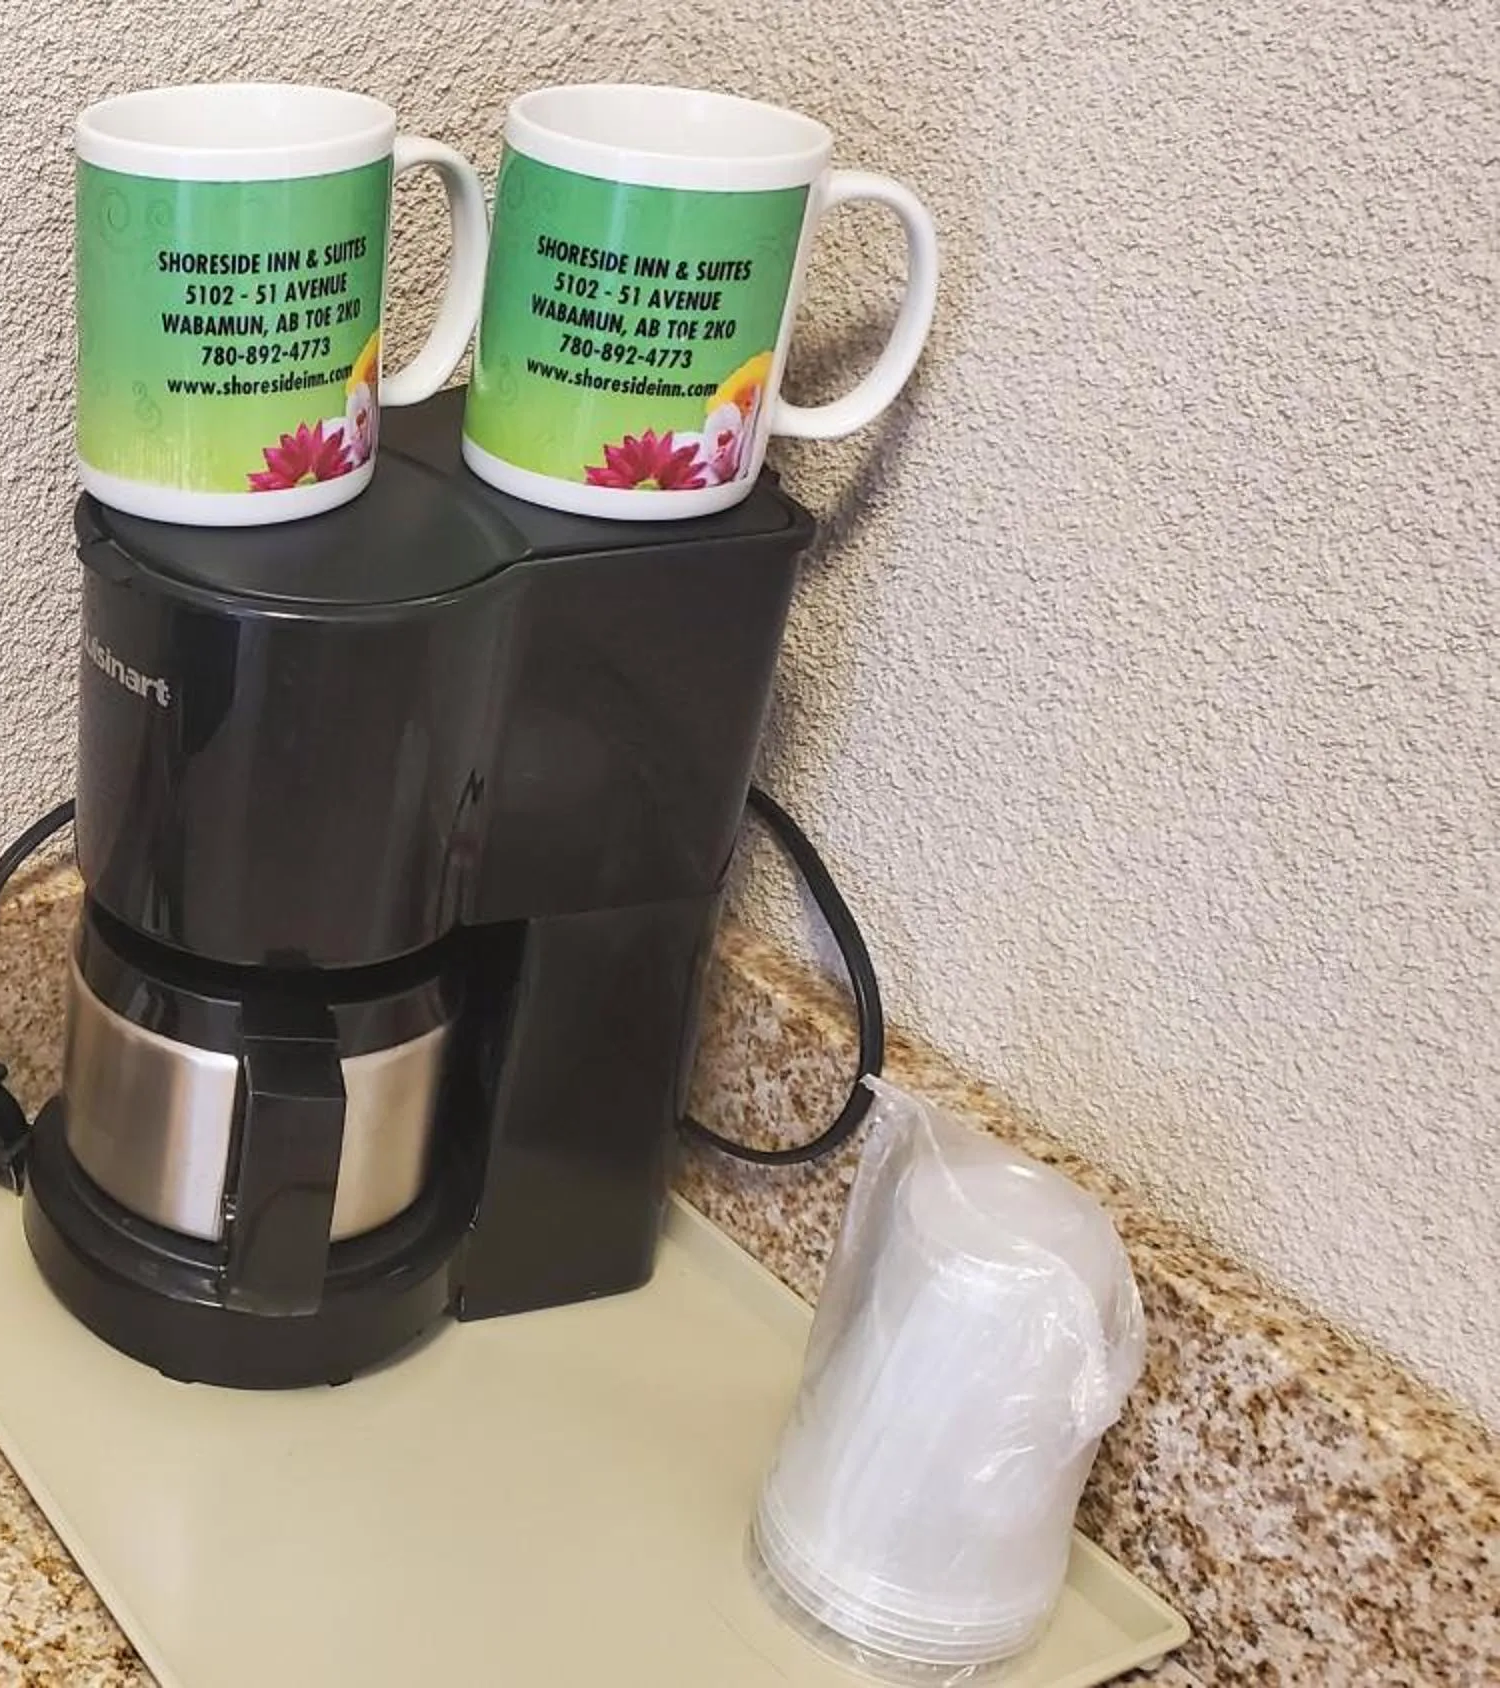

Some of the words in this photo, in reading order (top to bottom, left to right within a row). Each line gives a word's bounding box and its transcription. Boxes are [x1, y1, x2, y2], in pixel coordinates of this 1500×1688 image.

[158, 251, 260, 275] SHORESIDE
[267, 250, 300, 273] INN
[306, 249, 318, 268] &
[323, 236, 367, 267] SUITES
[536, 235, 629, 275] SHORESIDE
[633, 255, 671, 279] INN
[675, 261, 689, 281] &
[696, 259, 753, 281] SUITES
[185, 284, 234, 305] 5102
[255, 283, 277, 304] 51
[285, 272, 347, 302] AVENUE
[553, 271, 600, 299] 5102
[617, 284, 641, 306] 51
[647, 289, 722, 311] AVENUE
[161, 312, 269, 338] WABAMUN,
[275, 312, 299, 333] AB
[531, 293, 627, 337] WABAMUN,
[633, 317, 661, 338] AB
[201, 336, 331, 366] 780-892-4773
[558, 333, 693, 369] 780-892-4773
[167, 364, 353, 395] www.shoresideinn.com
[526, 357, 719, 398] www.shoresideinn.com
